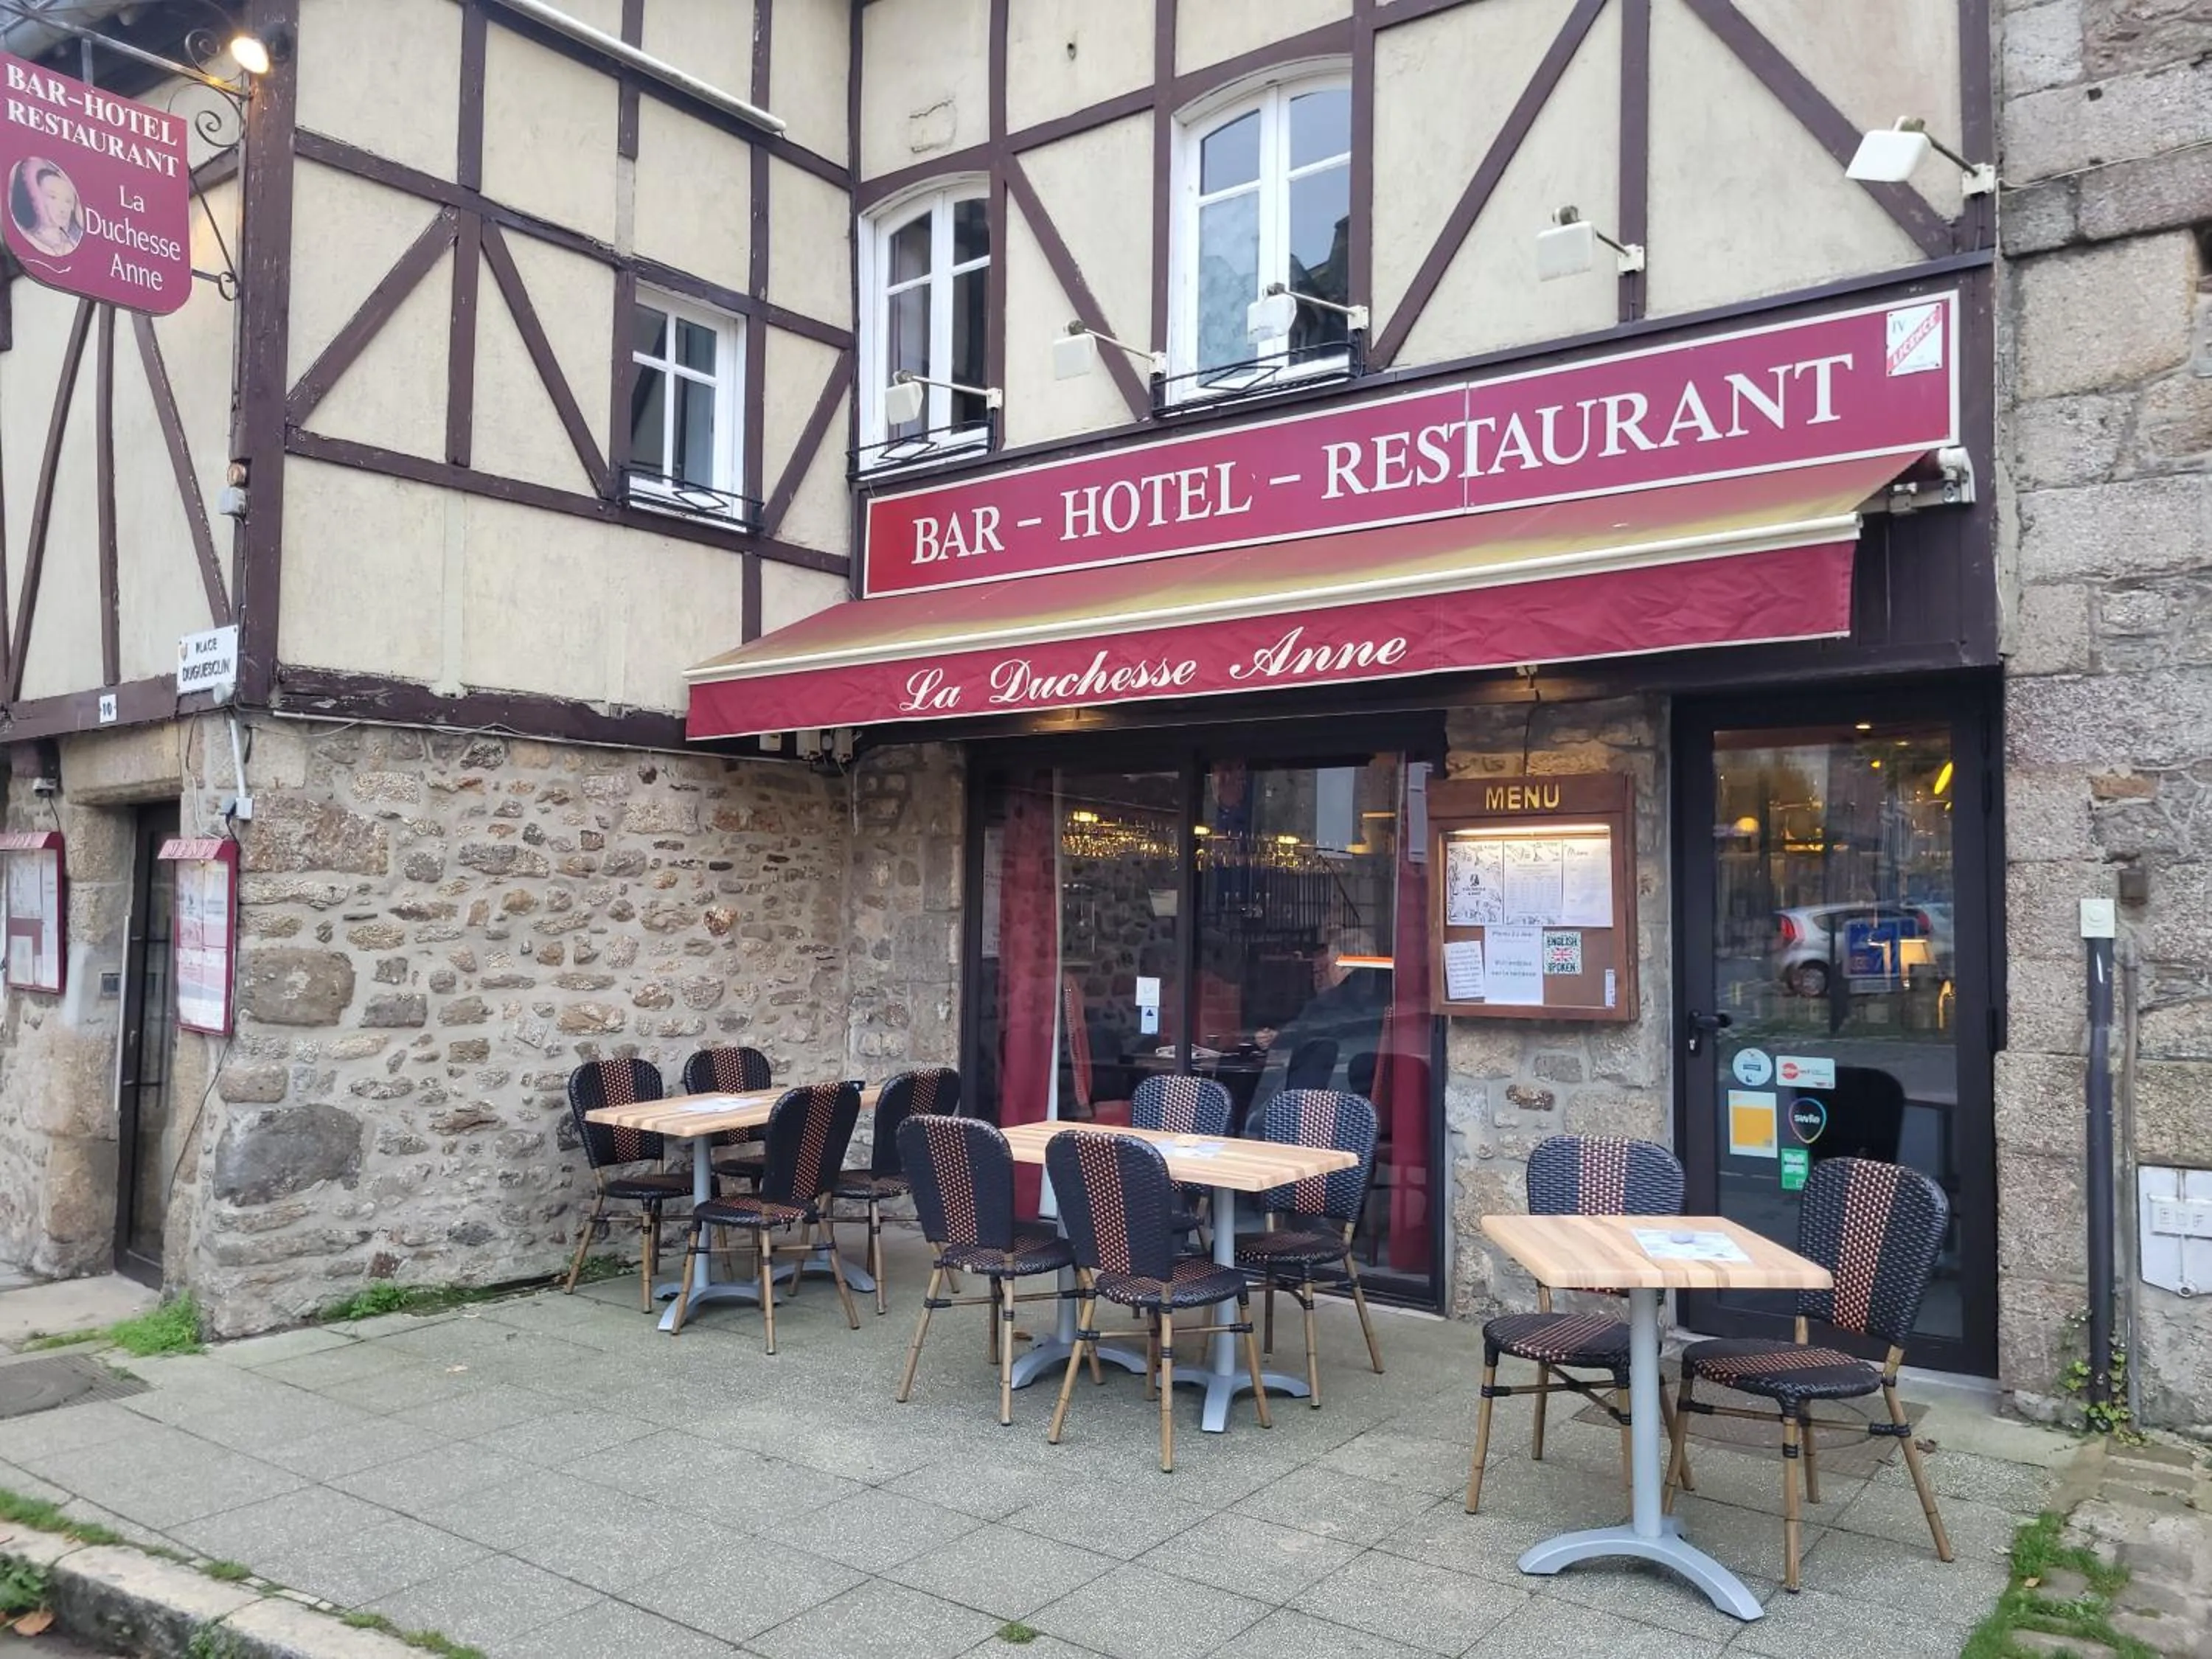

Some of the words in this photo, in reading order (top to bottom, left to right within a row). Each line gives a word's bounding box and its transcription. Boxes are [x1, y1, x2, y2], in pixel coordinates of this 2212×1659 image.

[6, 99, 179, 177] RESTAURANT
[119, 185, 145, 213] La
[86, 208, 181, 262] Duchesse
[111, 253, 164, 291] Anne
[911, 505, 1005, 565] BAR
[1059, 461, 1253, 541] HOTEL
[1321, 353, 1854, 501] RESTAURANT
[195, 638, 218, 654] PLACE
[182, 658, 231, 681] DUGUESCLIN
[900, 668, 961, 713] La
[989, 650, 1197, 704] Duchesse
[1229, 626, 1407, 679] Anne
[102, 701, 114, 716] 10
[1485, 784, 1560, 810] MENU
[1547, 936, 1577, 946] ENGLISH
[1547, 961, 1576, 973] SPOKEN
